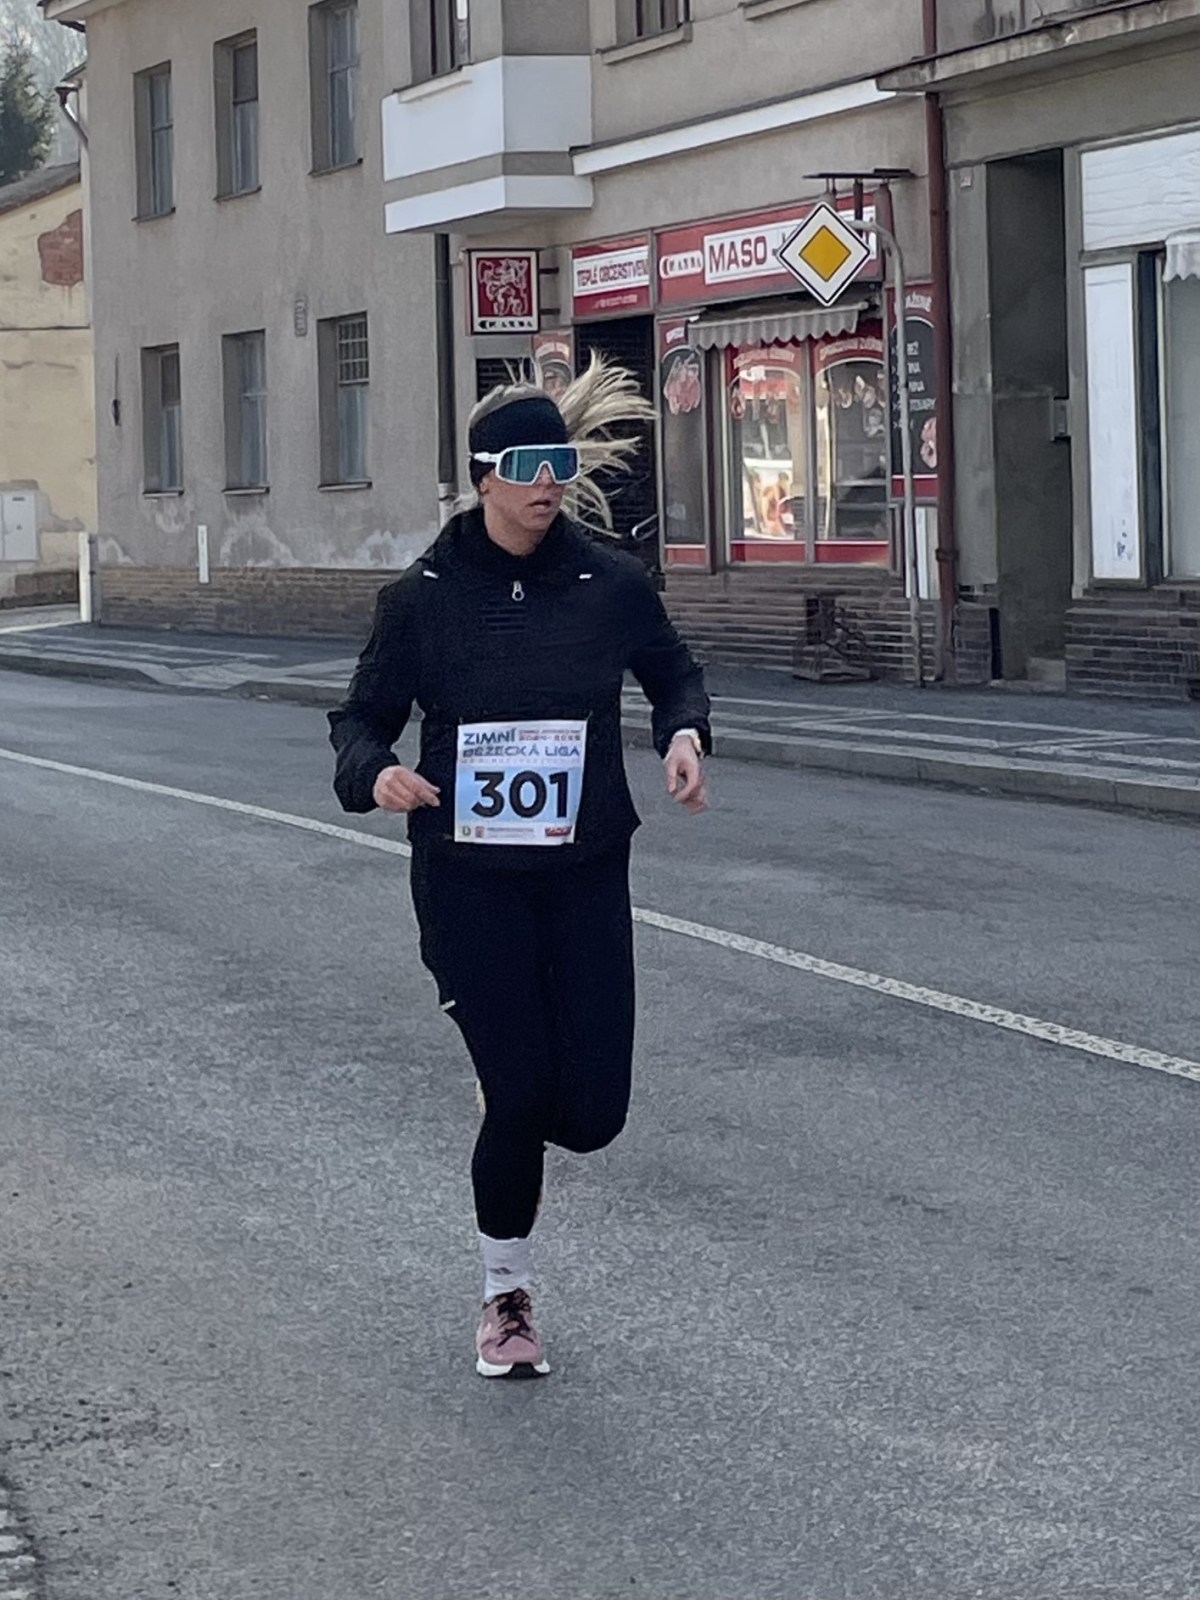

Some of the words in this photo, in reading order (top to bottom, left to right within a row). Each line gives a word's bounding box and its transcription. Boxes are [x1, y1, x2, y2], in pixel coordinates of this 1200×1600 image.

[708, 235, 768, 274] MASO
[599, 259, 649, 283] OBČERSTVEN
[464, 728, 516, 745] ZIMNÍ
[545, 745, 580, 757] LIGA
[470, 769, 569, 819] 301
